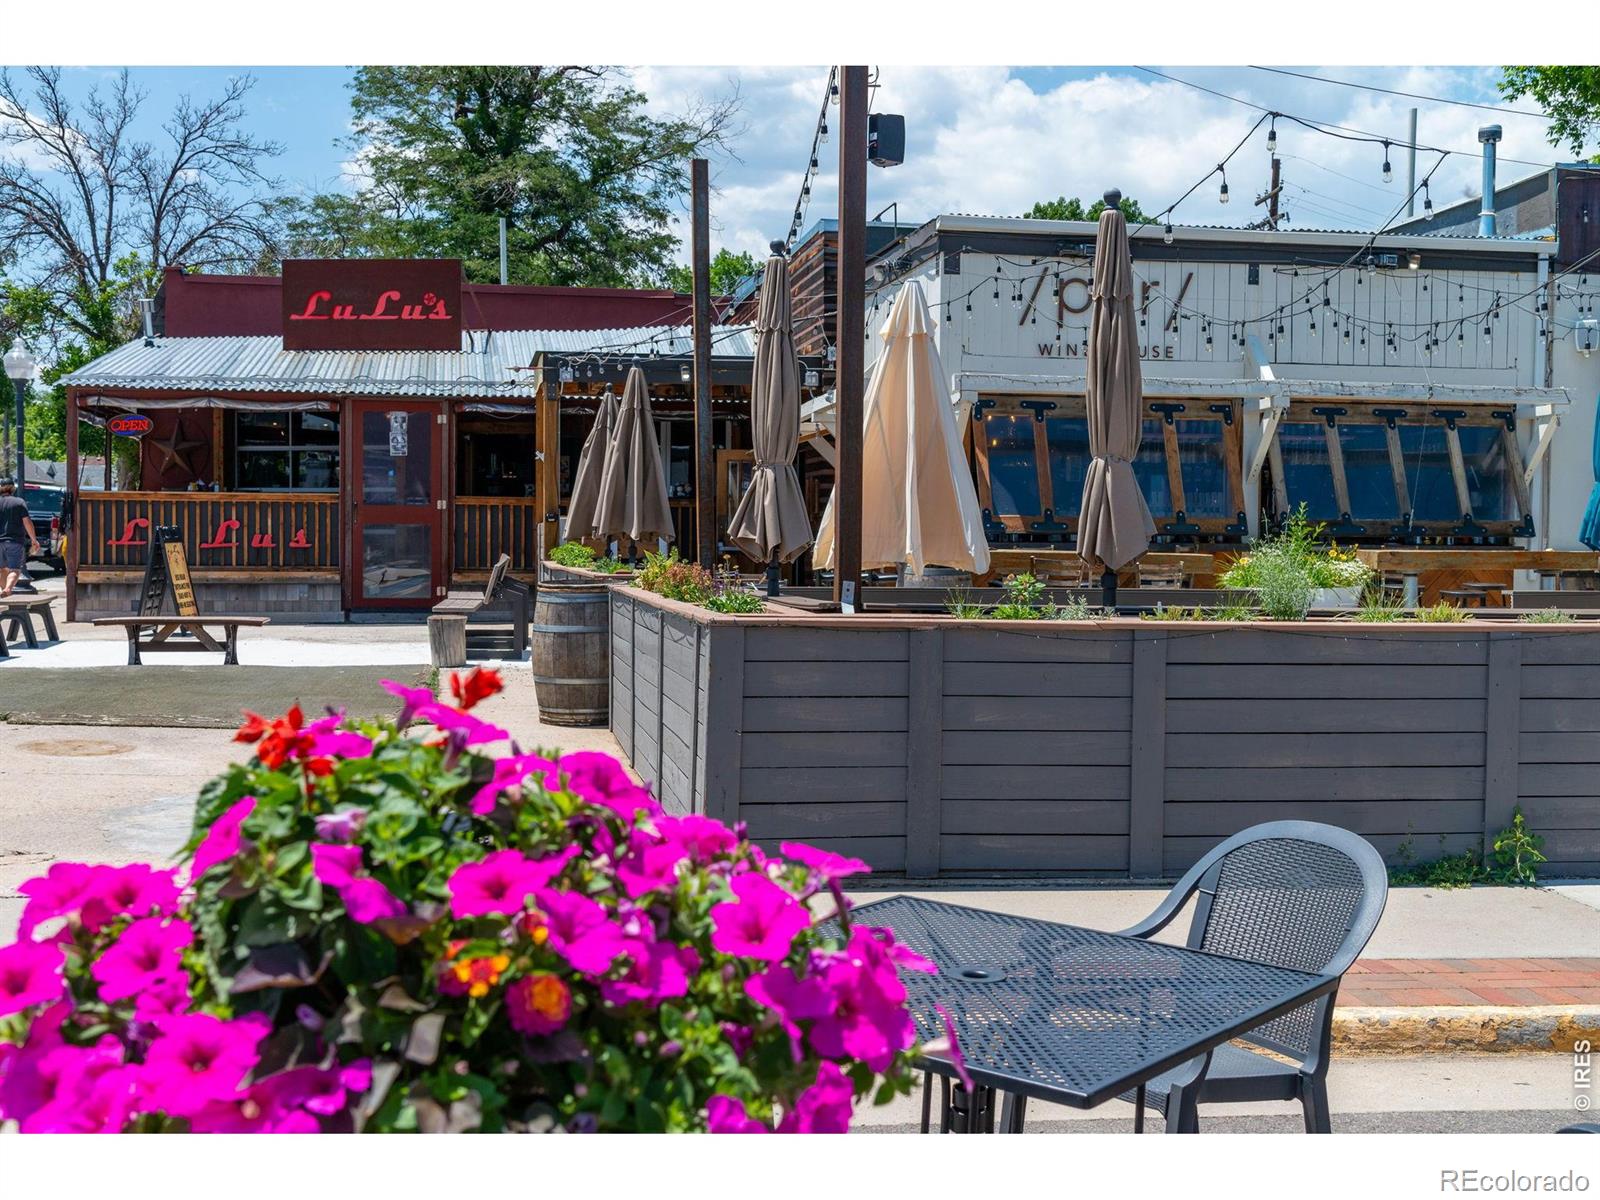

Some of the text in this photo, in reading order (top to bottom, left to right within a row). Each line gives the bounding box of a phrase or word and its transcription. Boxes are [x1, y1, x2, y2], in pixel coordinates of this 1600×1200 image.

[1018, 266, 1194, 332] /pr/
[1038, 343, 1175, 359] WIN USE
[111, 419, 149, 432] OPEN
